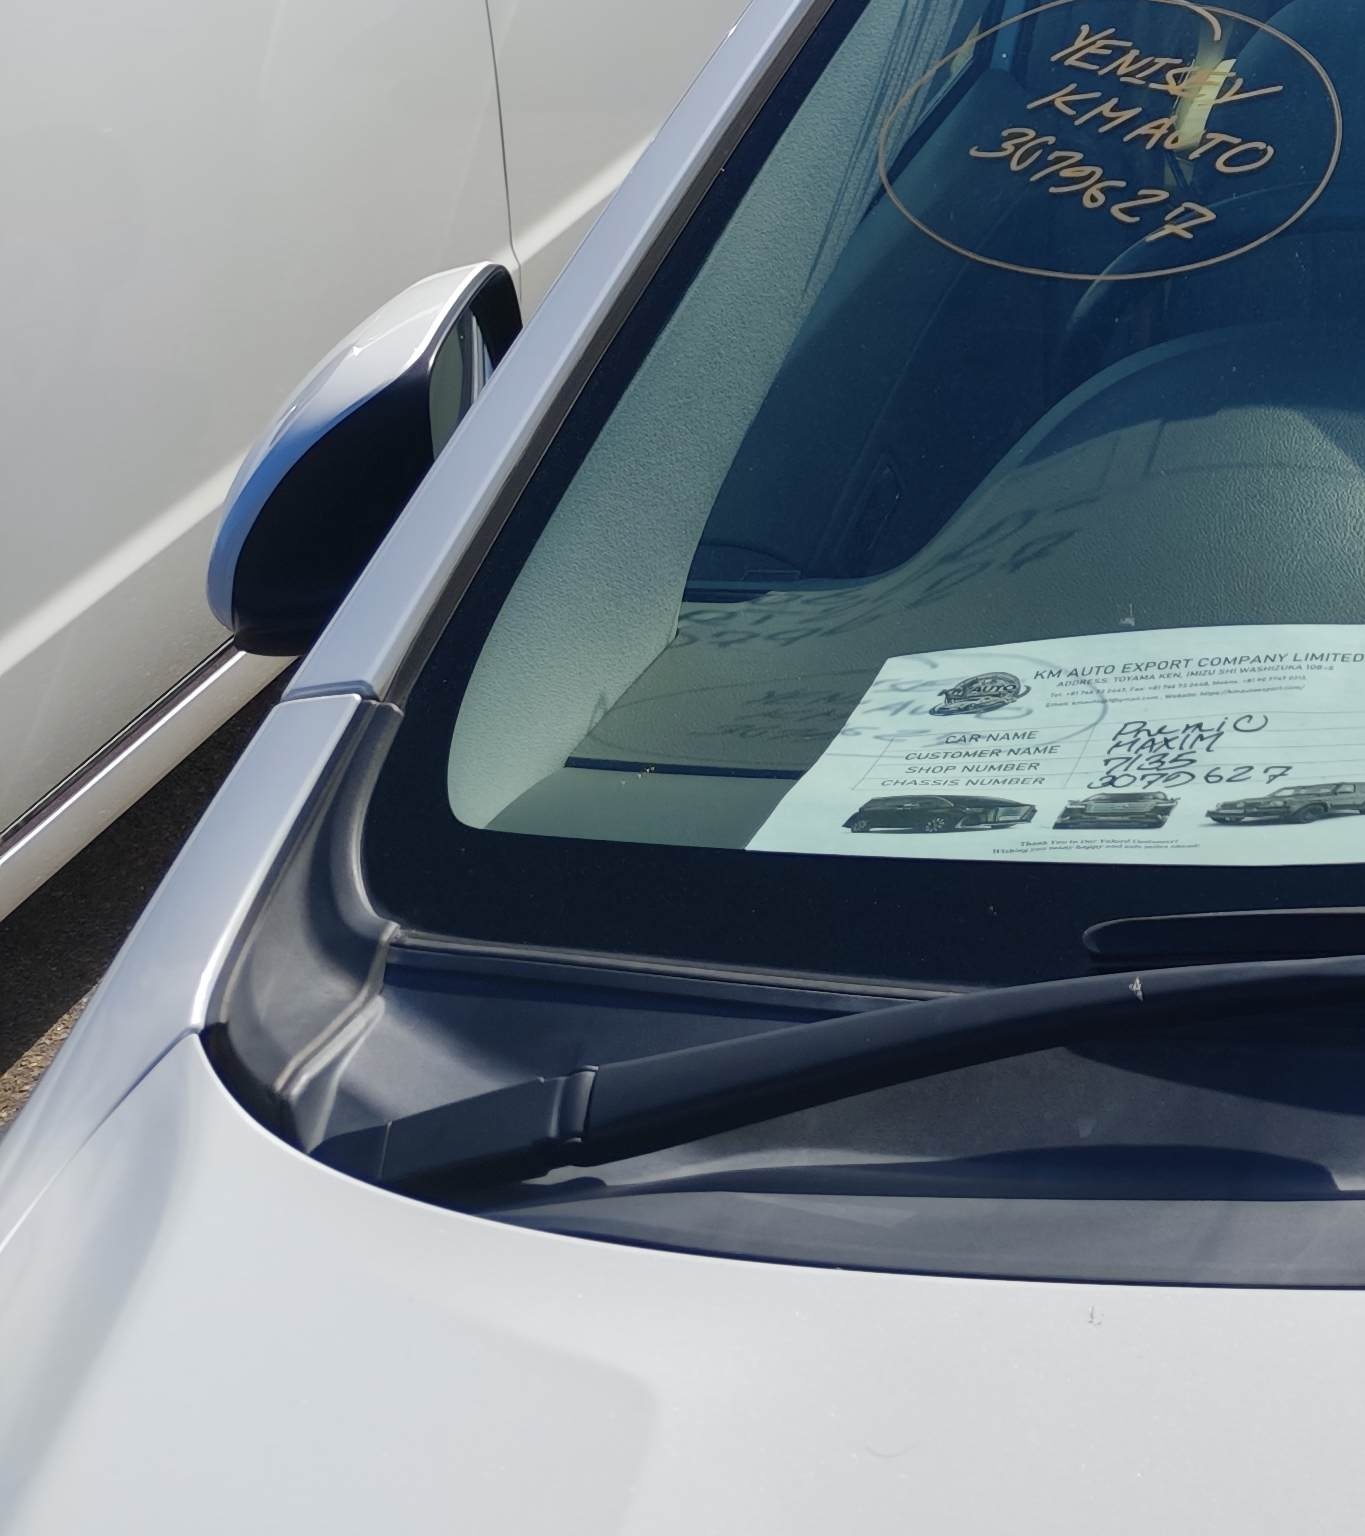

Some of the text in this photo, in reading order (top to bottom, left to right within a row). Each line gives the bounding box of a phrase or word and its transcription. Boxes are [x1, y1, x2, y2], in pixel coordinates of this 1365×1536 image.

[968, 128, 1217, 243] 3079627
[1033, 652, 1365, 680] KM AUTO EXPORT COMPANY LIMITED
[944, 730, 1040, 744] CAR NAME
[1107, 731, 1224, 755] MAXIM
[904, 745, 1062, 761] CUSTOMER NAME
[904, 762, 1041, 774] SHOP NUMBER
[881, 777, 1046, 787] CHASSIS NUMBER
